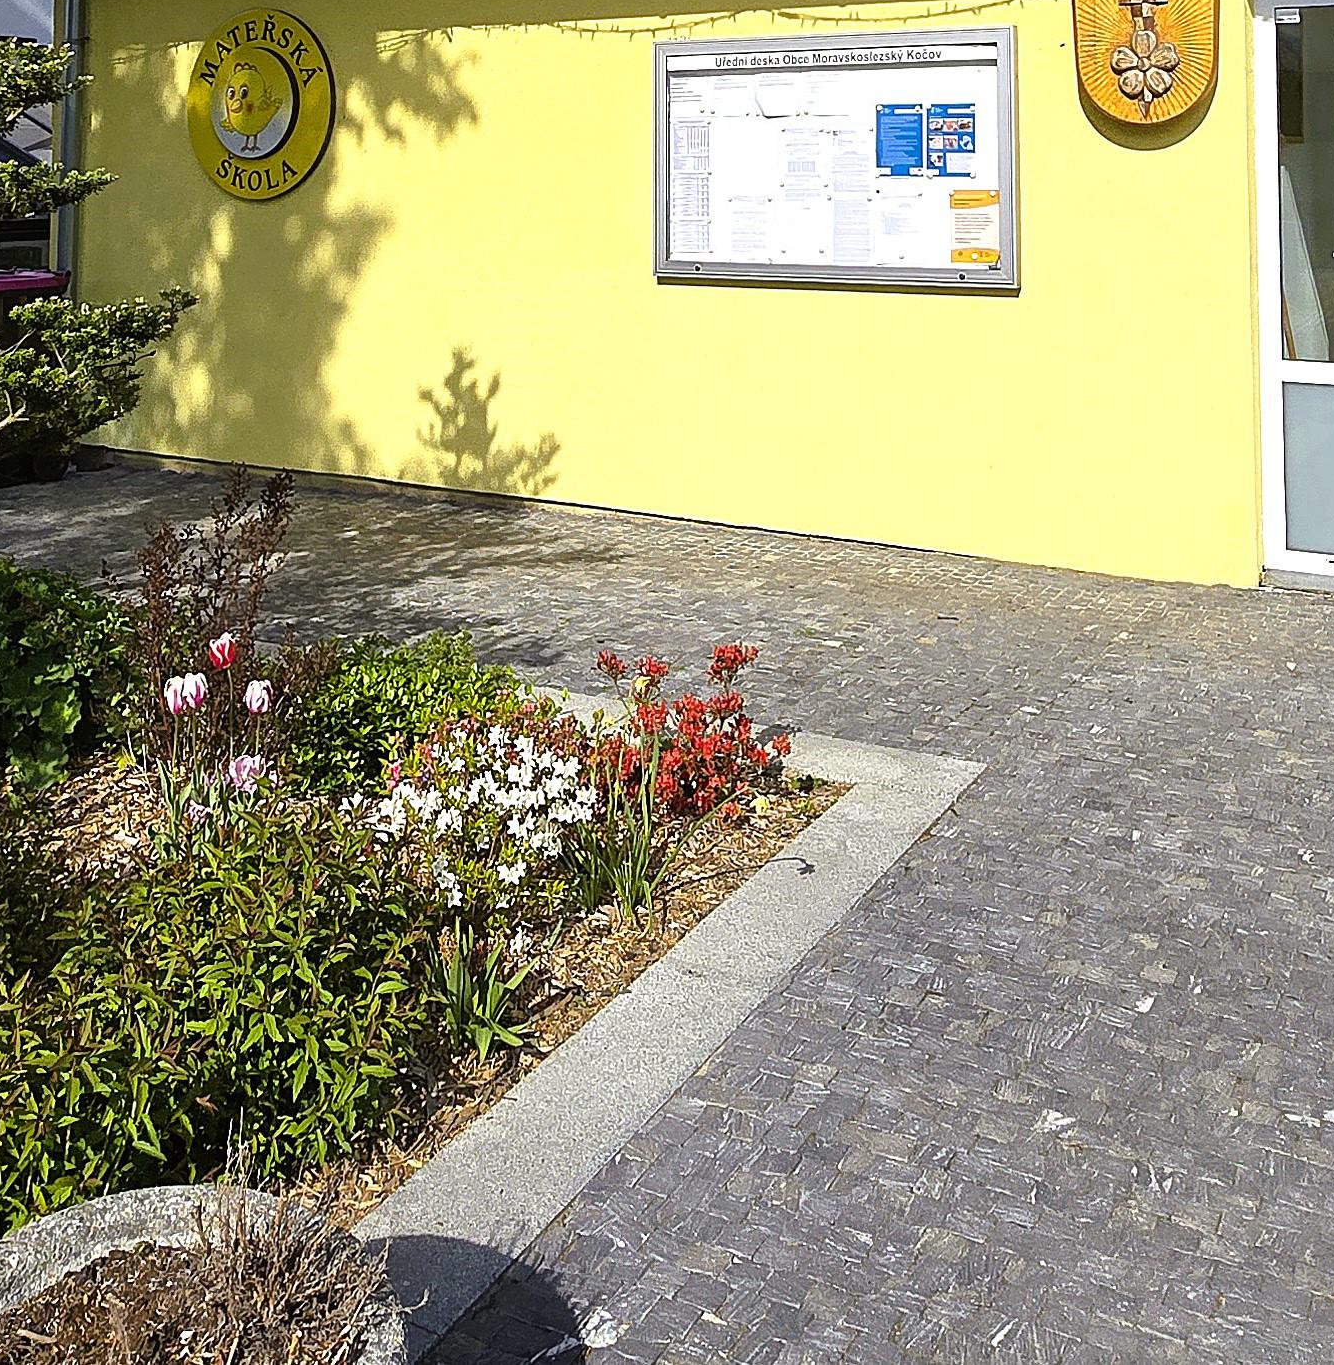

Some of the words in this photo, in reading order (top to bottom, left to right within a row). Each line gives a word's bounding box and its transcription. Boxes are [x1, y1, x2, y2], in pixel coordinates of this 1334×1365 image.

[200, 14, 323, 87] MATEŘSKÁ
[750, 53, 780, 65] deska
[782, 53, 810, 64] Obce
[812, 50, 903, 63] Moravskoslezský
[906, 48, 942, 60] Kočov
[216, 154, 298, 191] ŠKOLA
